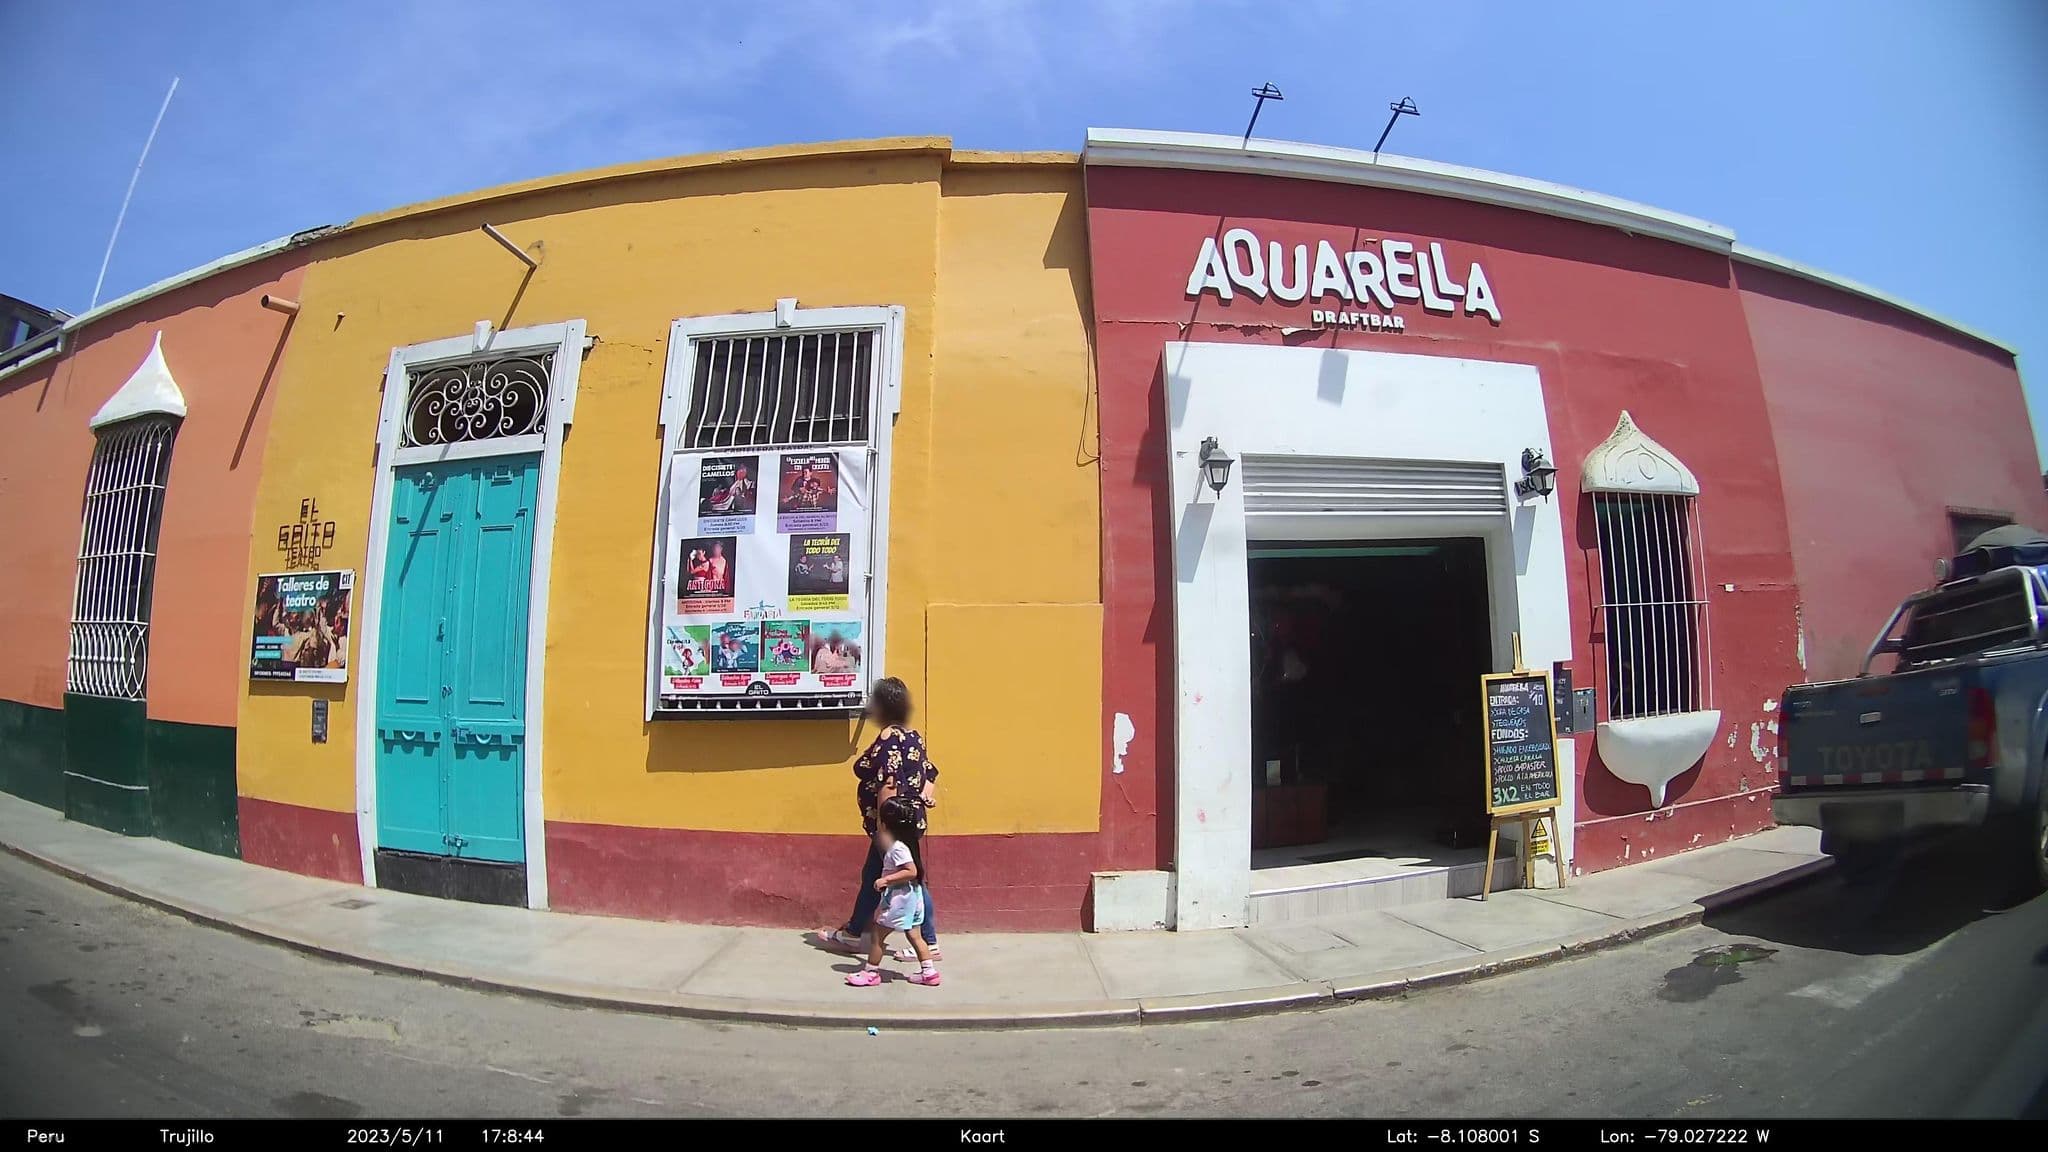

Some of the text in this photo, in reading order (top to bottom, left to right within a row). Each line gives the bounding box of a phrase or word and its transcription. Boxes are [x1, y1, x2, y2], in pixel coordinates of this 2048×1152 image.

[1186, 227, 1502, 324] AQUARELLA
[1312, 309, 1405, 330] DRAFTBAR
[702, 470, 735, 478] CAMELLOS
[277, 575, 330, 593] Talleres de
[284, 593, 317, 607] teatro
[1491, 728, 1529, 740] FONDOS:
[1817, 739, 1934, 772] TOYOTA
[1520, 784, 1531, 792] EN
